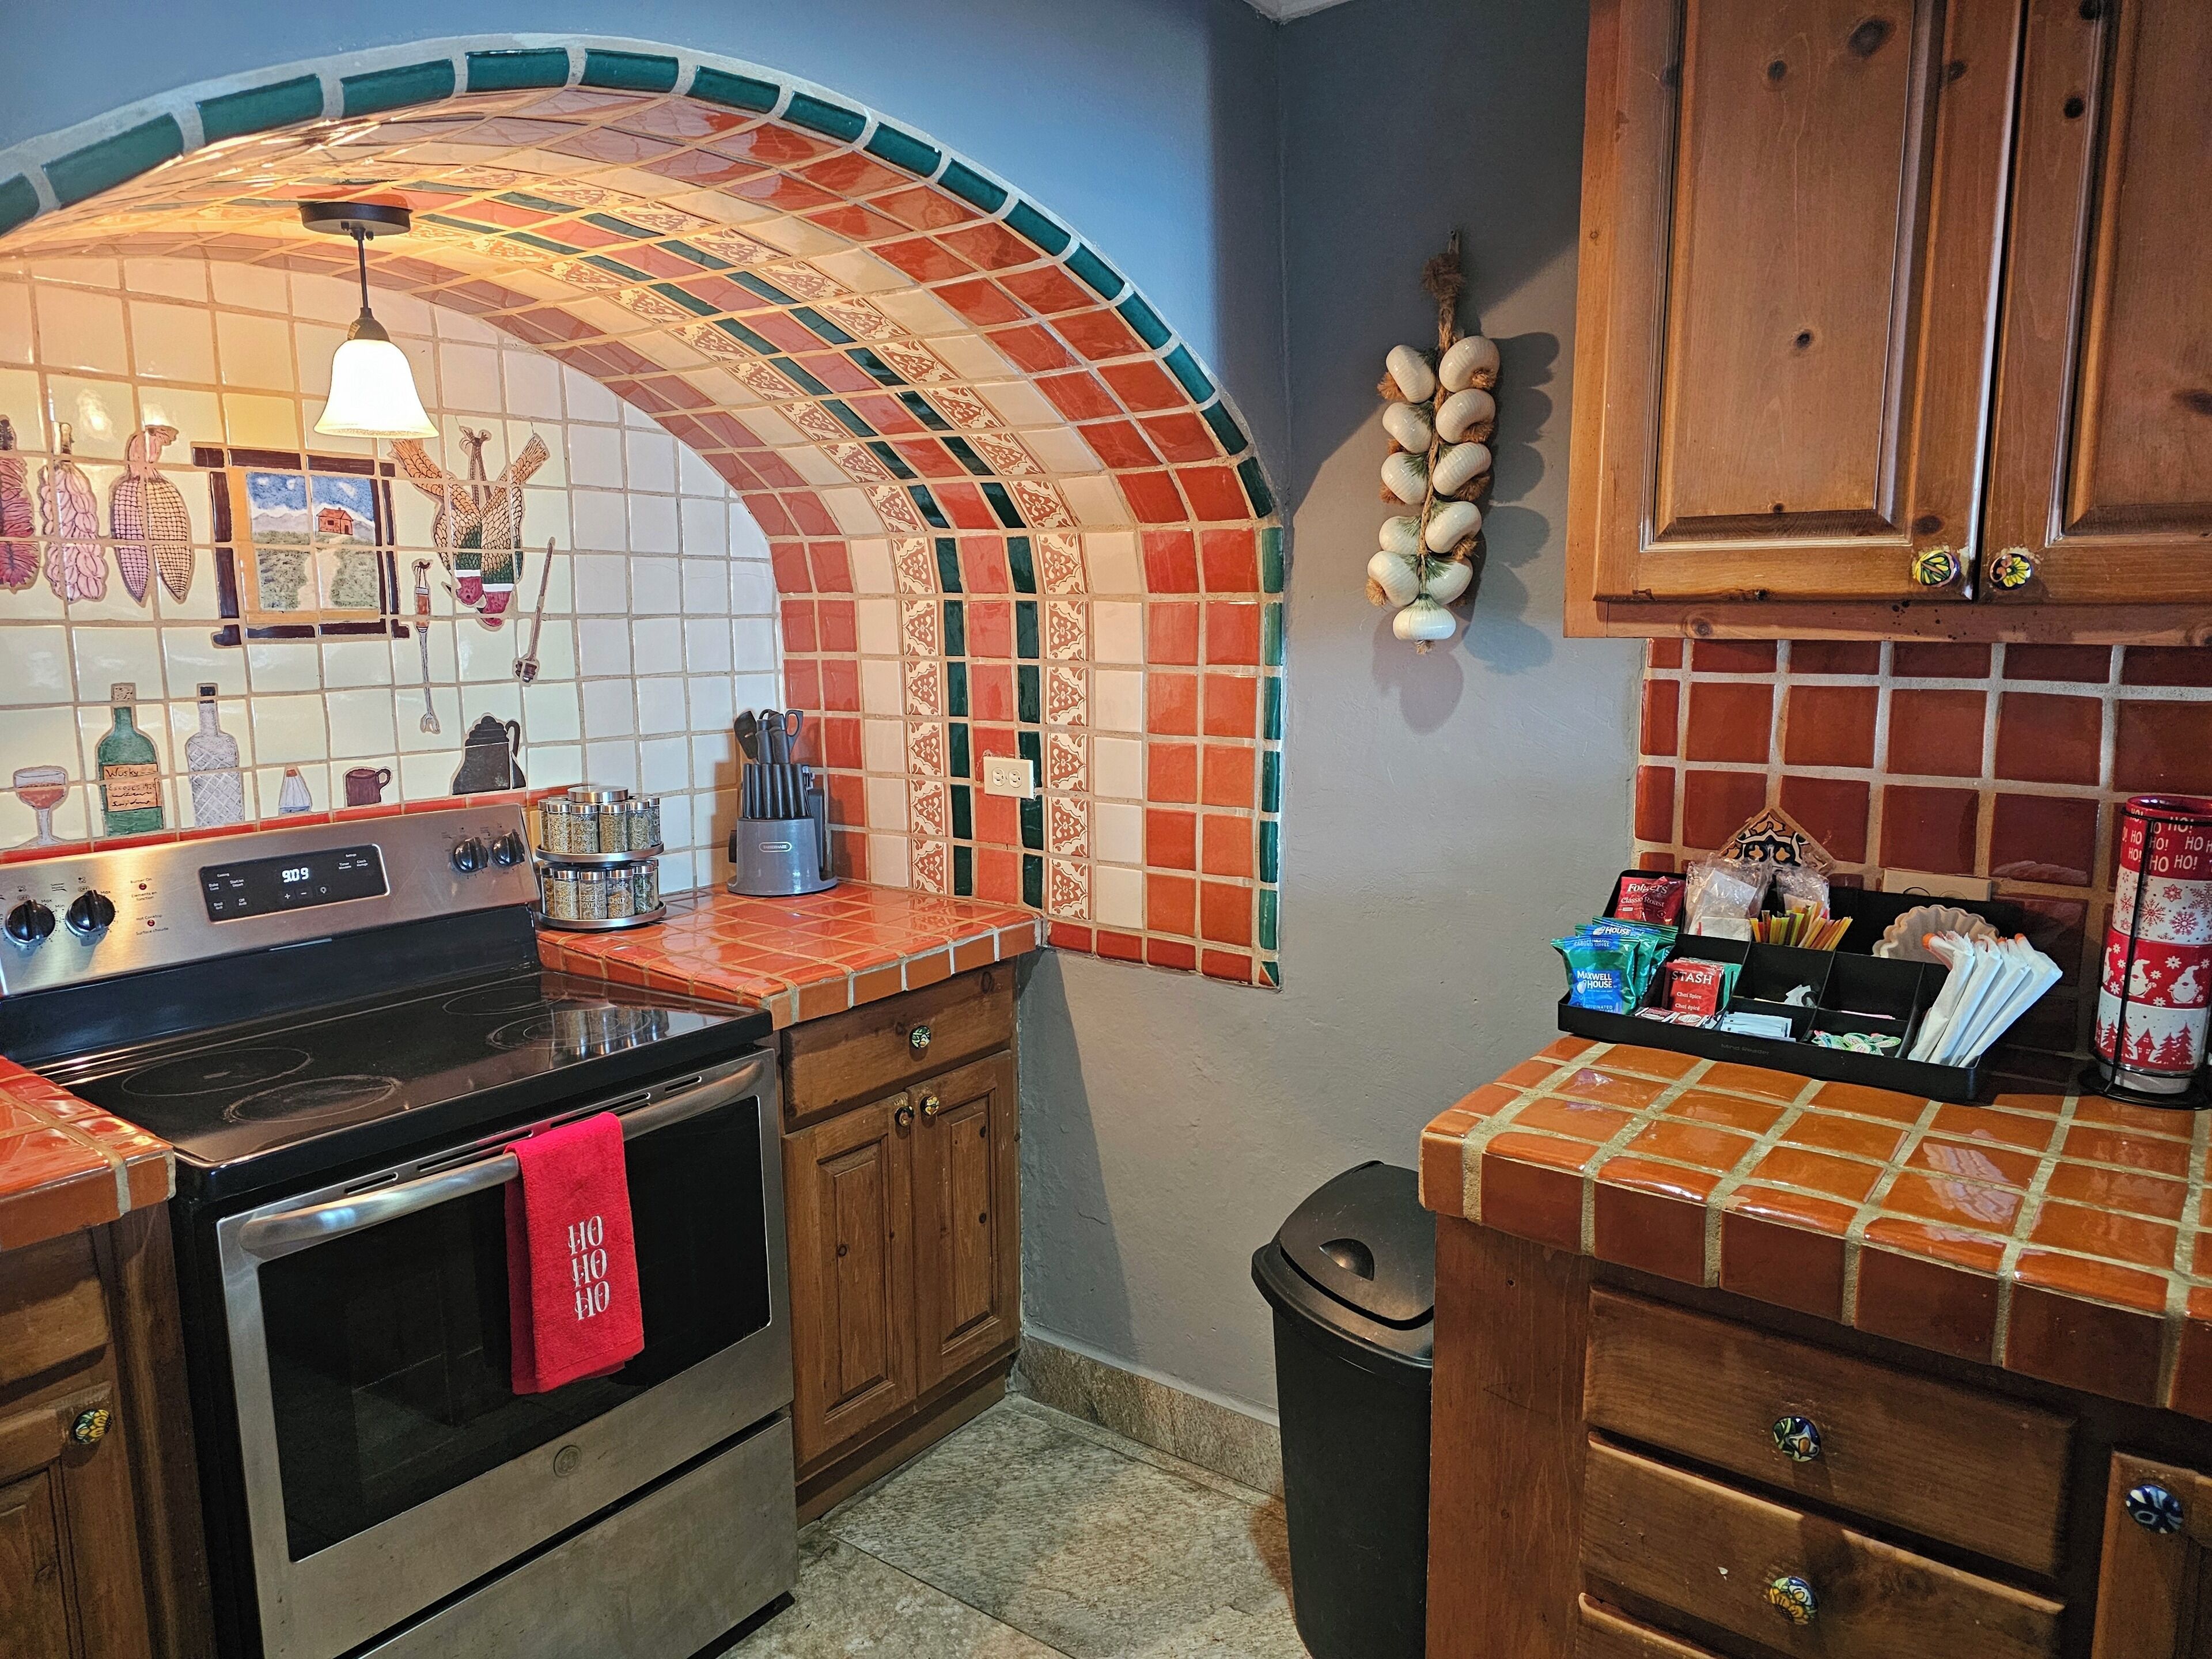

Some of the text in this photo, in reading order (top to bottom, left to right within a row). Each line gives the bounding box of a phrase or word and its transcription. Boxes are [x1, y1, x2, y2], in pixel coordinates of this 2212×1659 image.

[2130, 830, 2142, 845] HO
[2184, 836, 2204, 851] HO
[2128, 847, 2198, 872] HO! HO HO!
[1627, 883, 1668, 895] Folgers
[1644, 896, 1665, 907] Roast
[1605, 926, 1631, 935] HOUSE
[1577, 970, 1612, 980] MAXWELL
[1672, 971, 1713, 985] STASH
[1587, 980, 1613, 989] HOUSE
[568, 1215, 603, 1256] HO
[571, 1248, 607, 1288] HO
[574, 1281, 610, 1321] HO
